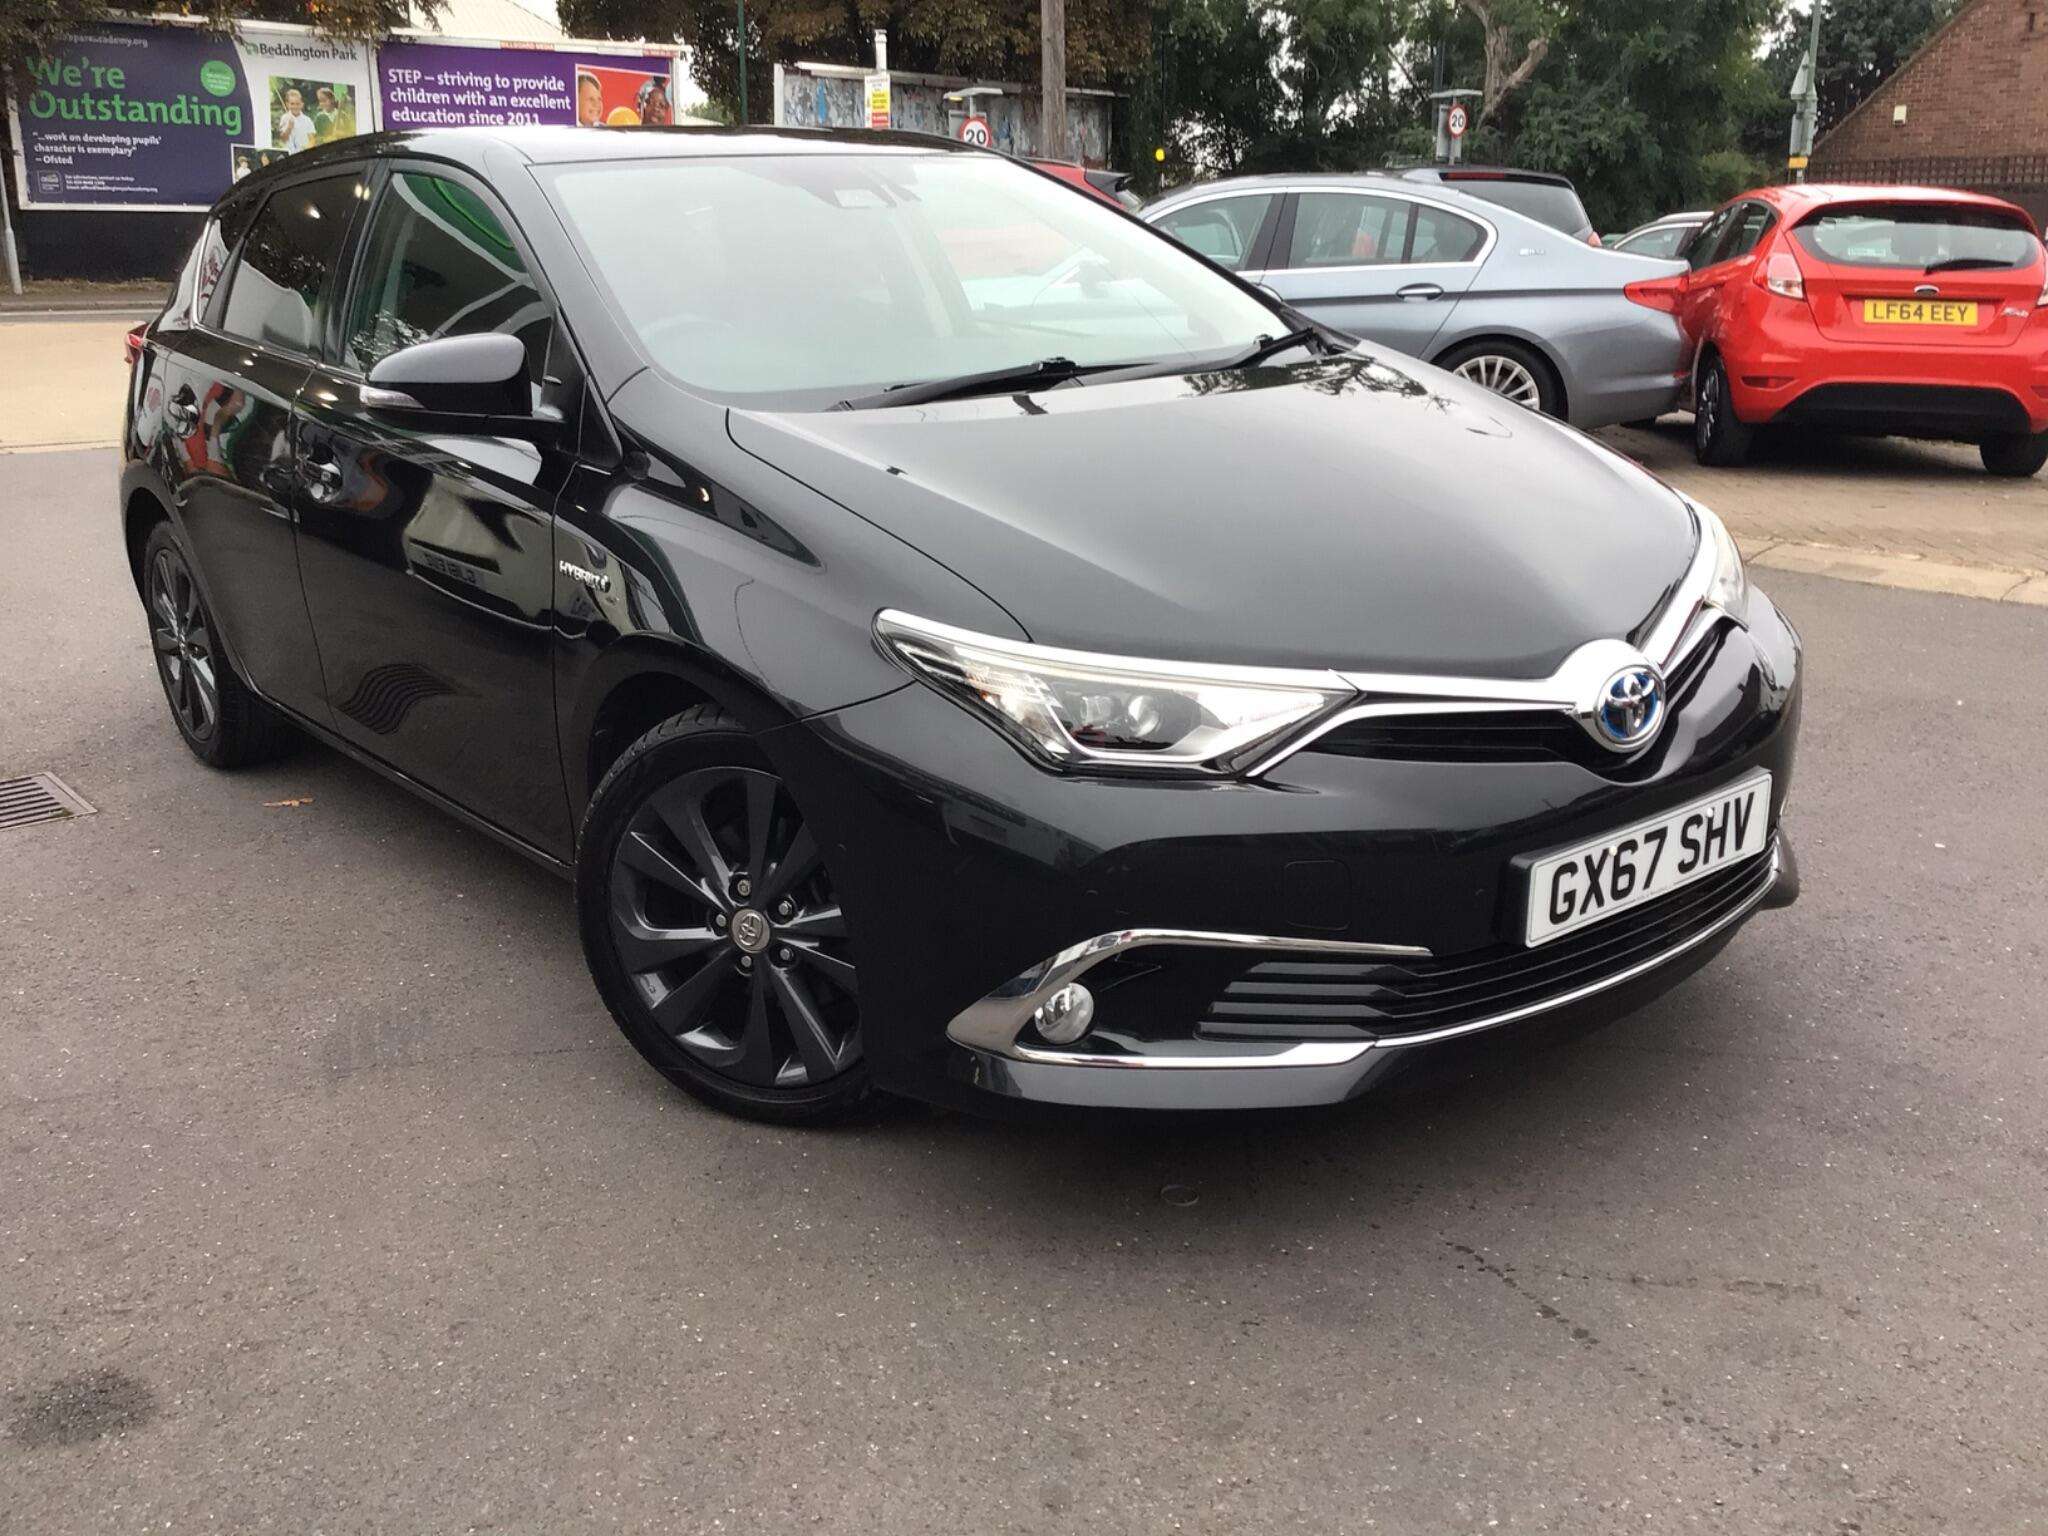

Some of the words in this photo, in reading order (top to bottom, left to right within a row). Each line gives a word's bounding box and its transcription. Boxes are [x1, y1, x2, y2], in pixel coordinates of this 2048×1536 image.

[259, 43, 330, 61] Beddington
[332, 47, 358, 61] Park
[25, 56, 125, 89] We're
[388, 68, 422, 84] STEP
[437, 70, 492, 92] striving
[495, 74, 510, 88] to
[512, 76, 566, 93] provide
[390, 87, 450, 104] children
[453, 90, 486, 106] with
[489, 95, 507, 107] an
[510, 94, 571, 110] excellent
[29, 90, 242, 135] Outstanding
[392, 106, 466, 124] education
[468, 109, 504, 125] since
[507, 112, 542, 126] 2011
[1452, 113, 1465, 128] 20
[69, 133, 81, 142] on
[83, 132, 132, 146] developing
[966, 129, 986, 145] 20
[34, 143, 76, 153] character
[78, 144, 85, 154] is
[43, 155, 74, 165] Ofsted
[1873, 303, 1924, 321] LF64
[1930, 304, 1969, 322] EEY
[1550, 827, 1668, 926] GX67
[1677, 792, 1755, 875] SHV
